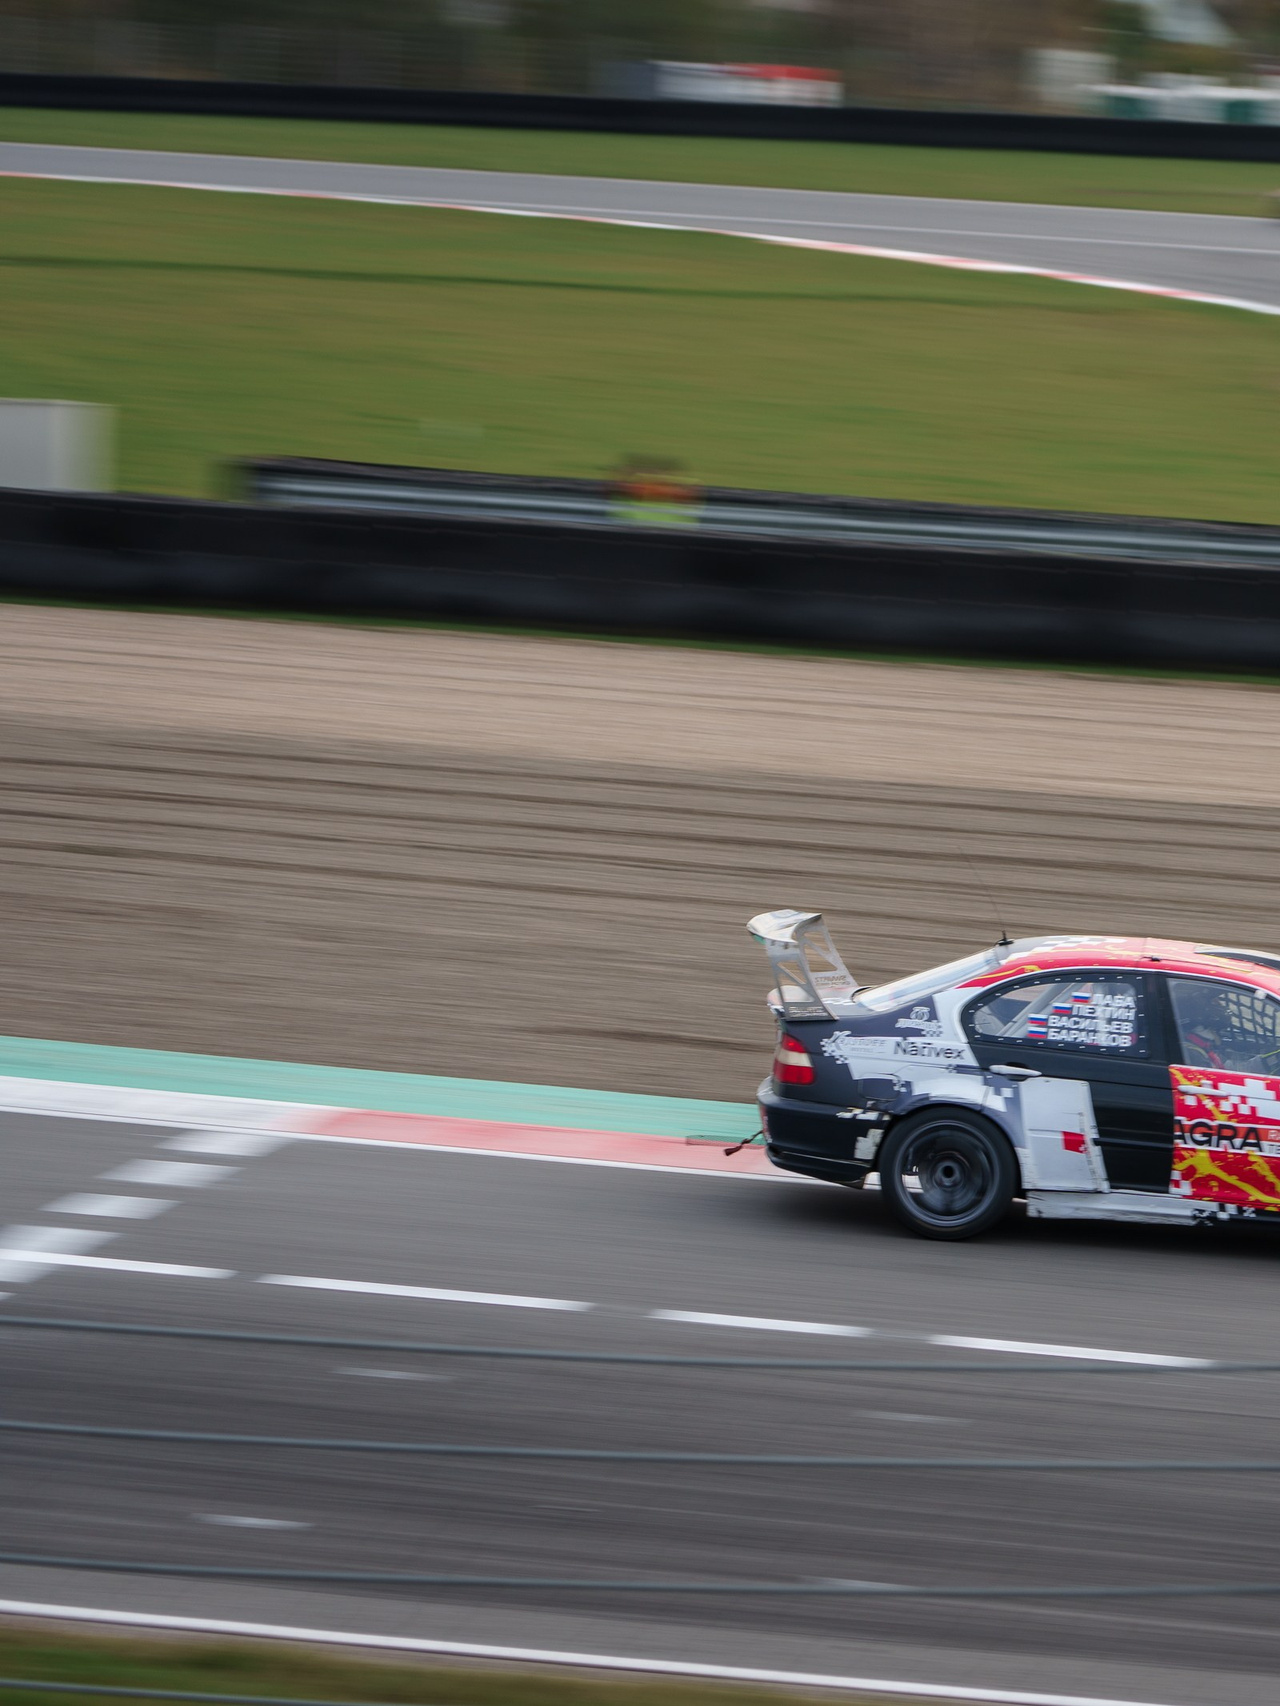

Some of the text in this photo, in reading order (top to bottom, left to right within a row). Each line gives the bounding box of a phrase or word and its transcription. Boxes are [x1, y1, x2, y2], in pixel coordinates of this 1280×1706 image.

[1072, 1004, 1135, 1020] ПЕХТИН
[1047, 1015, 1133, 1034] ВАСИЛЬЕВ
[1047, 1028, 1132, 1047] БАРАНКОВ
[893, 1040, 965, 1060] Nativex
